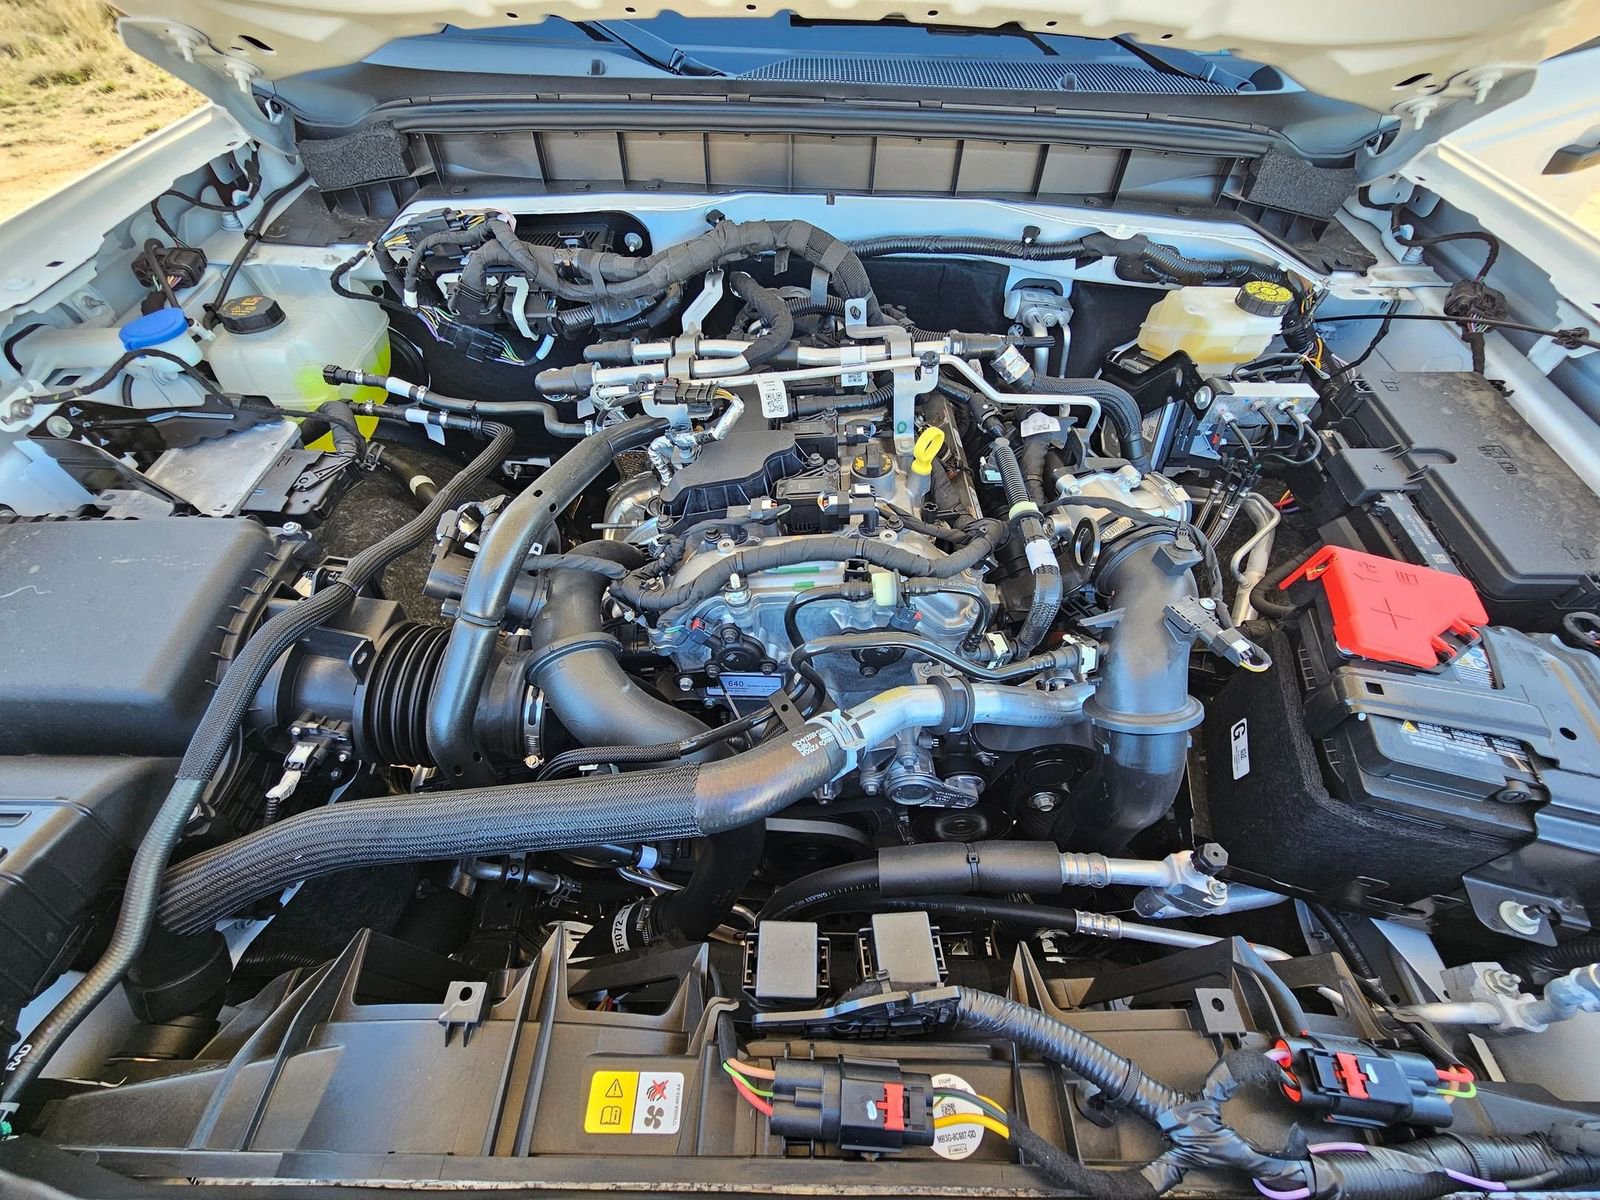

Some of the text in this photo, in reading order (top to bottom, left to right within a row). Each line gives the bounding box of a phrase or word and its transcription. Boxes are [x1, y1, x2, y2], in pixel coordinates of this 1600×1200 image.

[728, 680, 744, 688] 640
[1233, 722, 1246, 741] G
[5, 1044, 32, 1071] RAD
